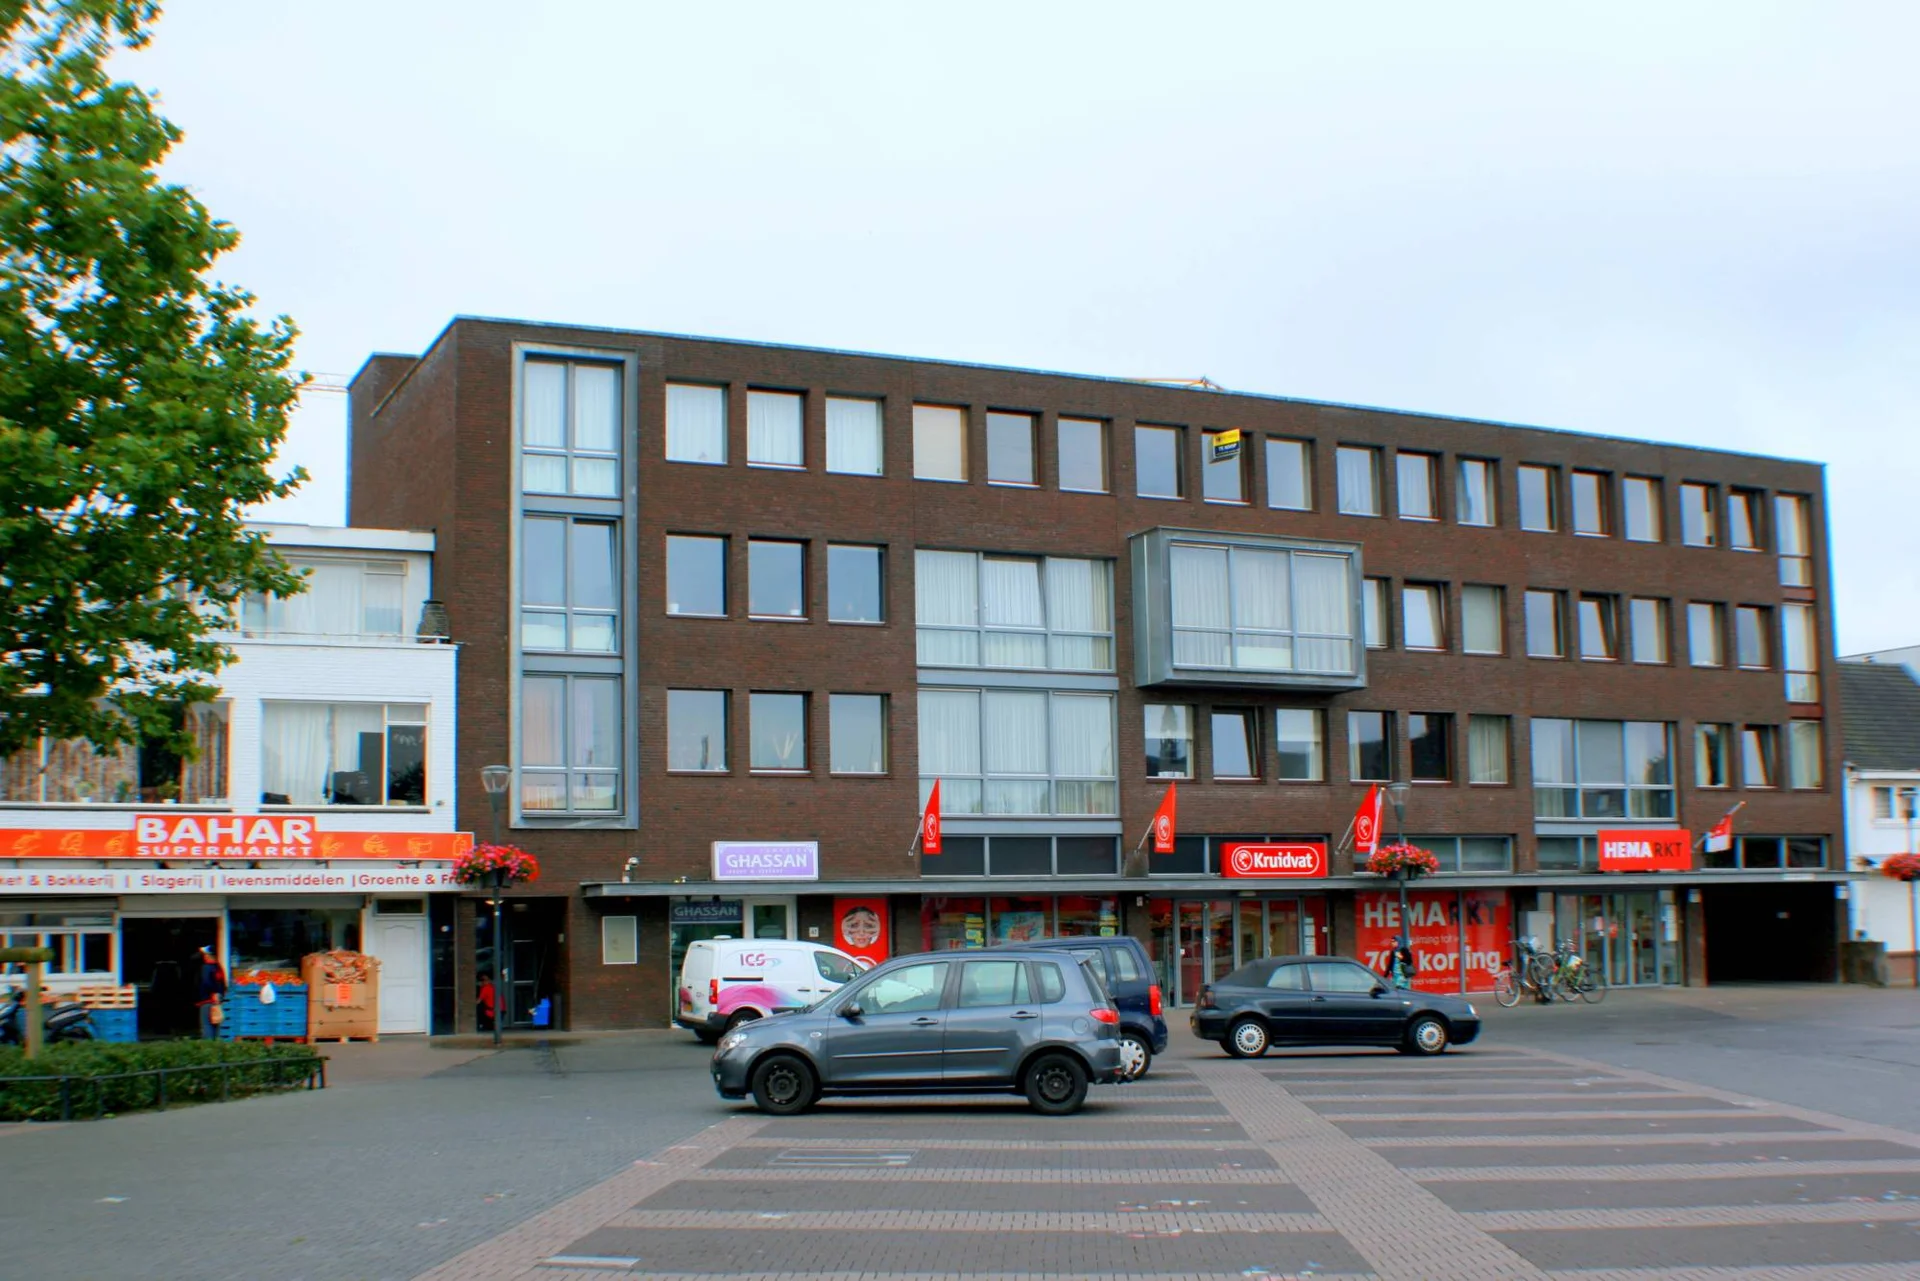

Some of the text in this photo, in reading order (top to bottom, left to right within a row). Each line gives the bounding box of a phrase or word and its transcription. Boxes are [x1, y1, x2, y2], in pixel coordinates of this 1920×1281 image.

[136, 817, 312, 845] BAHAR
[136, 846, 312, 856] SUPERMARKT
[1604, 841, 1683, 858] HEMARKT
[725, 854, 807, 868] GHASSAN
[1253, 851, 1313, 868] Kruidvat
[47, 874, 114, 889] Bakkerij
[141, 874, 204, 889] Slagerij
[222, 874, 344, 887] levensmiddelen
[358, 874, 420, 886] Groente
[674, 905, 738, 917] GHASSAN
[739, 952, 766, 967] ICS
[1418, 945, 1501, 974] koring
